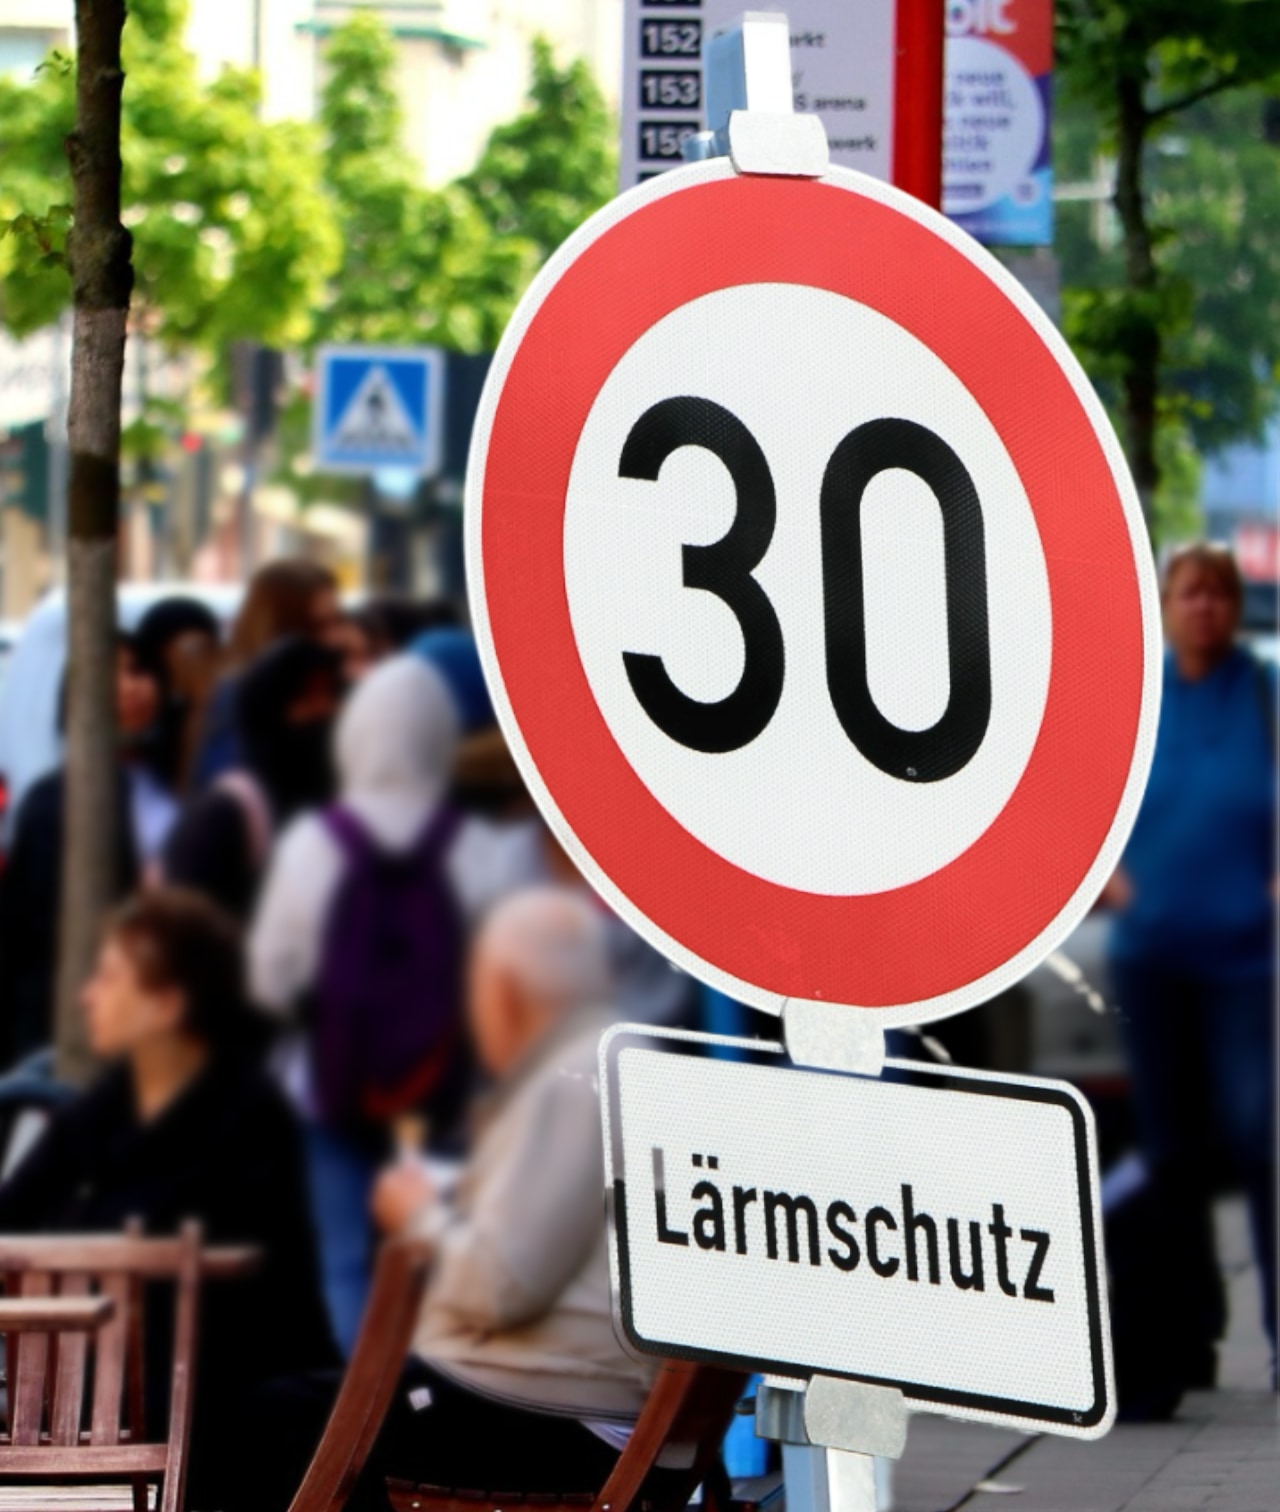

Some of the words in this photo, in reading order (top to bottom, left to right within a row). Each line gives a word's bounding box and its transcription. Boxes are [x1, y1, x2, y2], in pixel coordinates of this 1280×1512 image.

[644, 23, 698, 53] 152
[643, 76, 698, 105] 153
[827, 134, 877, 151] werk
[618, 395, 992, 783] 30
[652, 1147, 1055, 1303] Lärmschutz
